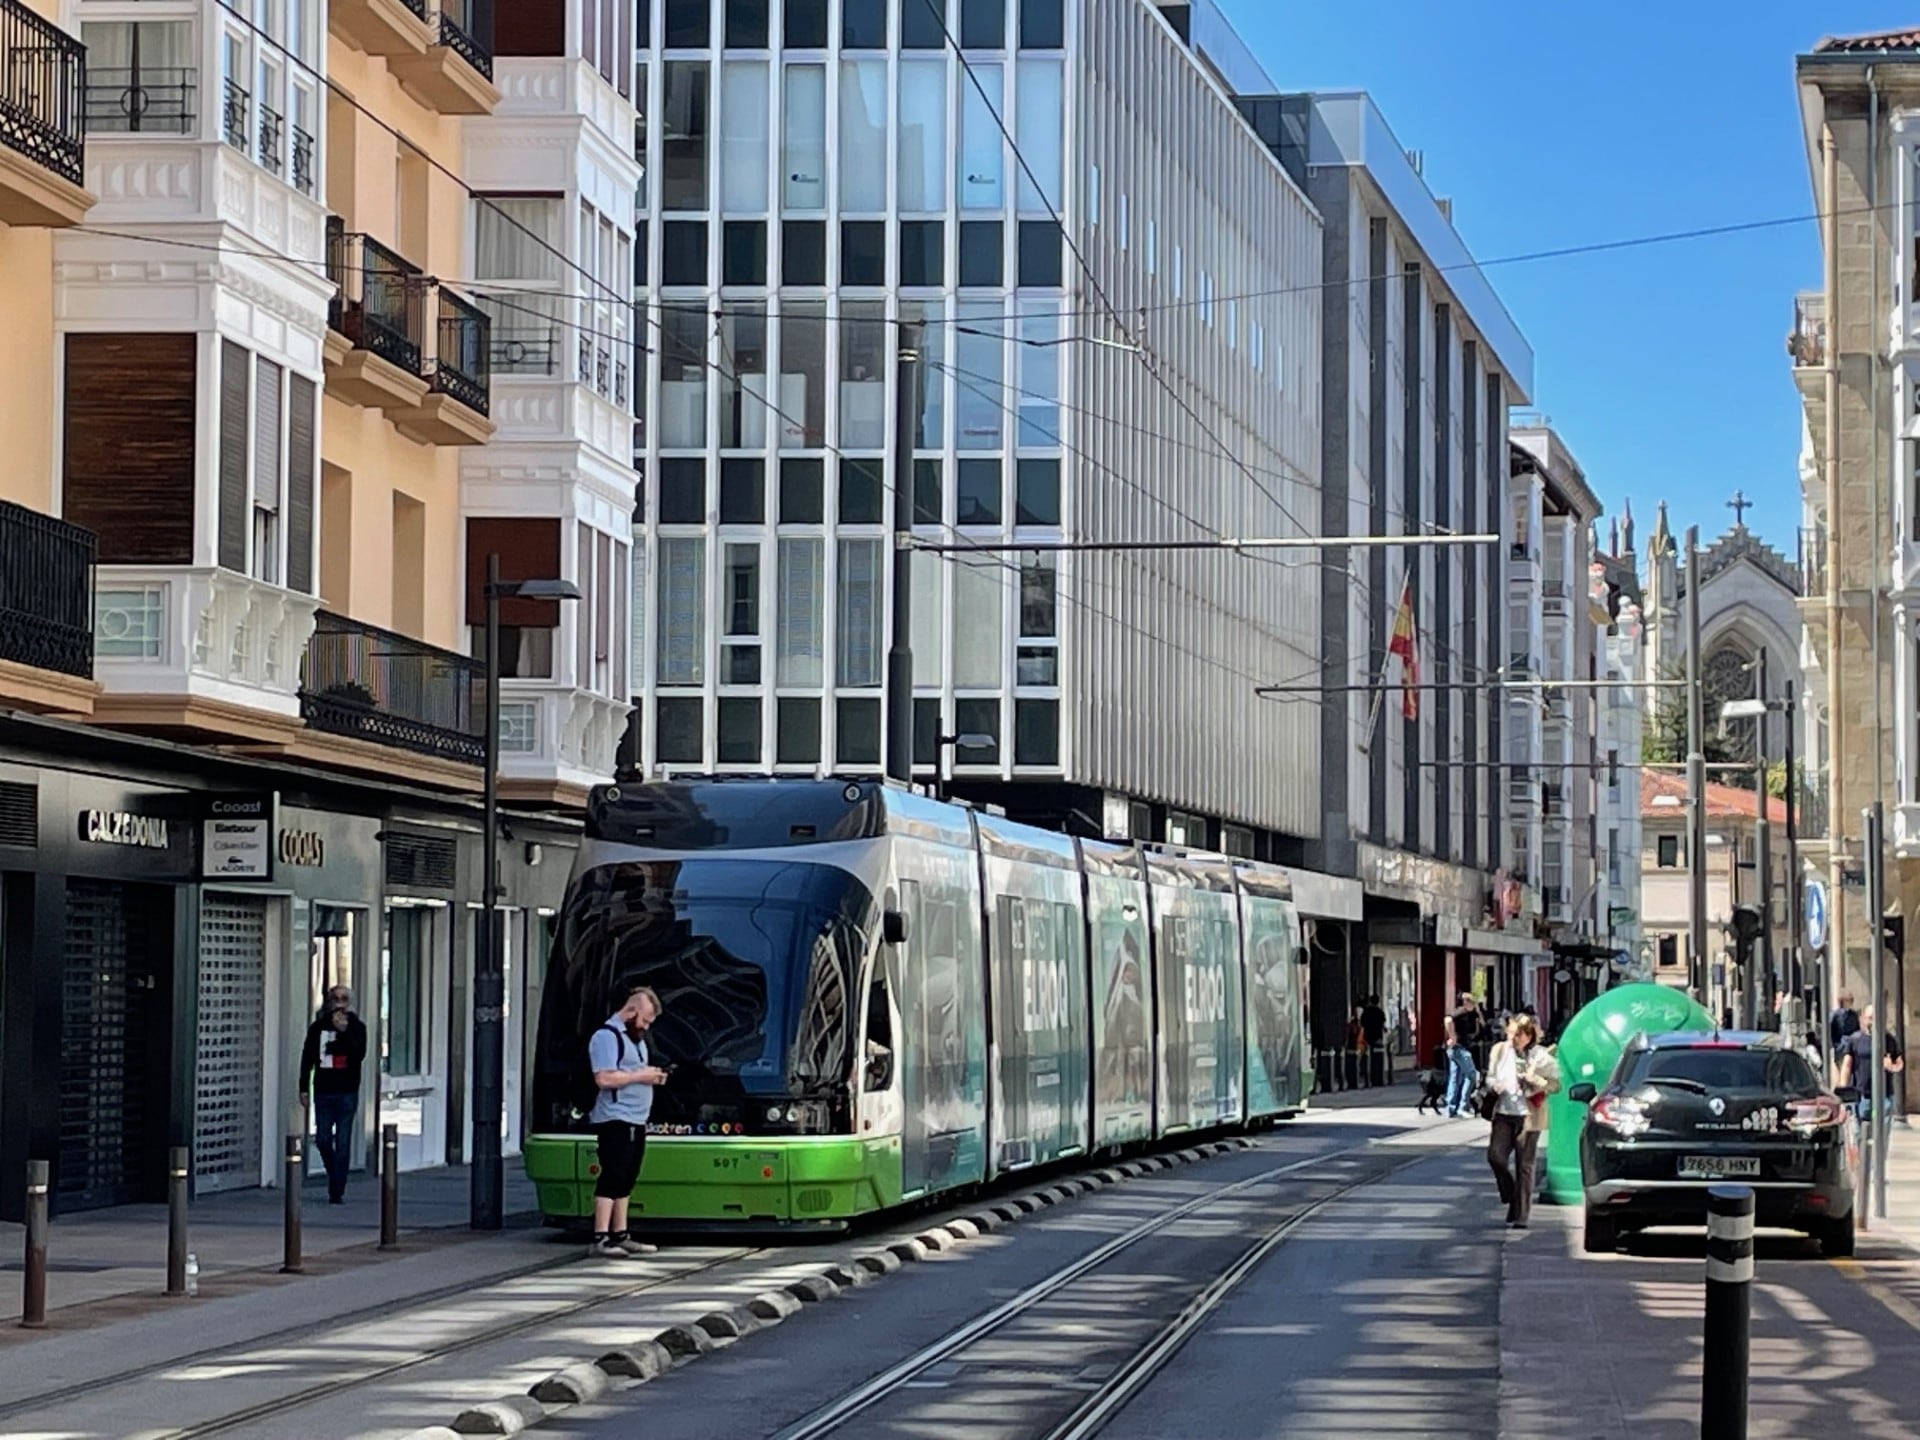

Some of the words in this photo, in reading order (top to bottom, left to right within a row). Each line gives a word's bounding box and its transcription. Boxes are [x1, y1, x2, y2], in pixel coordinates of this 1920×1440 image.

[212, 800, 261, 813] Cooast
[86, 808, 168, 849] CALZEDONIA
[214, 823, 258, 833] Barbour
[1023, 958, 1069, 1032] ELROQ
[1184, 963, 1225, 1023] ELROQ
[1728, 1160, 1757, 1172] HNY
